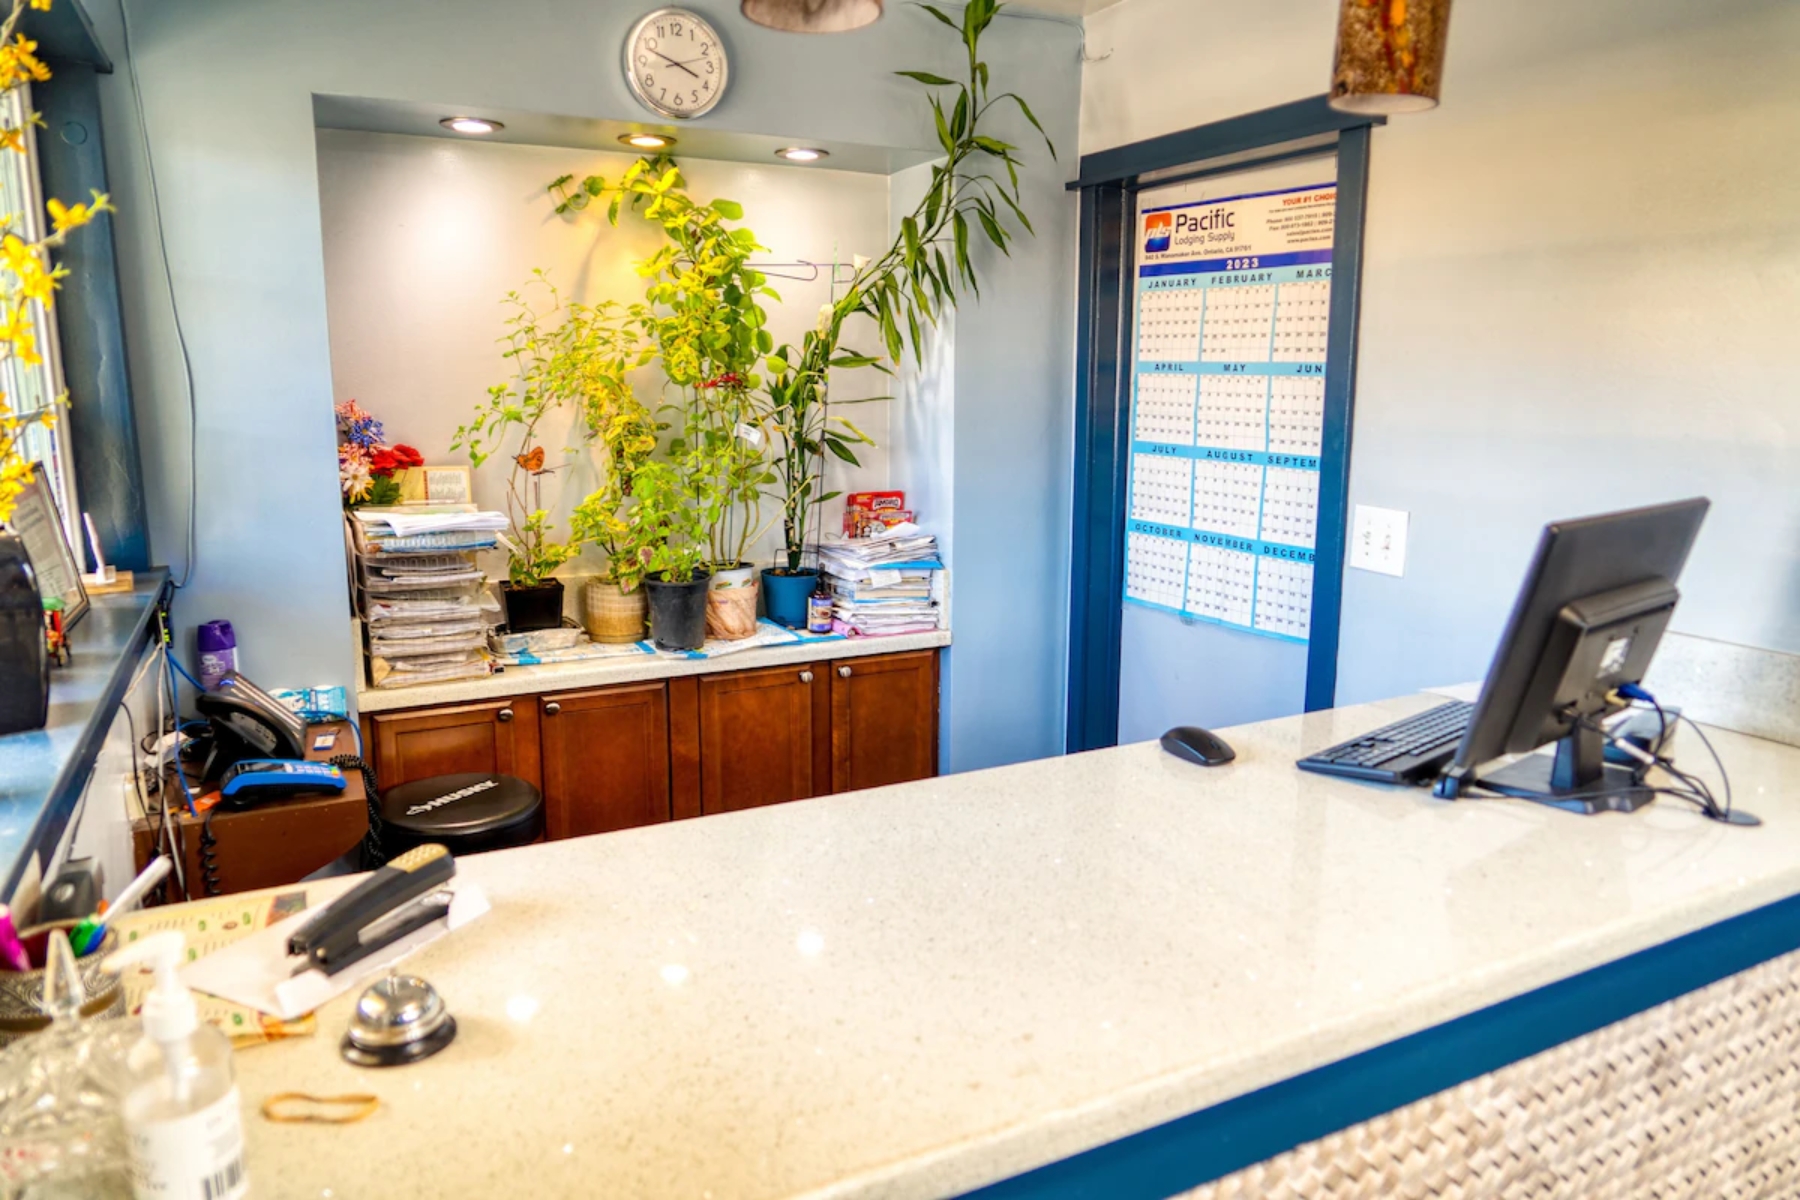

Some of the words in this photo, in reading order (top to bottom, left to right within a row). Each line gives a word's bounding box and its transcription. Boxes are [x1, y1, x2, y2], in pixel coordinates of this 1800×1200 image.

[656, 25, 665, 39] 11
[669, 22, 683, 37] 12
[689, 29, 694, 41] 1
[644, 37, 658, 50] 10
[700, 41, 709, 56] 2
[638, 54, 648, 68] 9
[706, 61, 715, 74] 3
[644, 73, 655, 88] 8
[702, 79, 709, 92] 4
[660, 87, 667, 101] 7
[673, 92, 684, 106] 6
[691, 89, 699, 103] 5
[1282, 196, 1302, 206] YOUR
[1175, 208, 1235, 234] Pacific
[1174, 234, 1205, 246] Lodging
[1207, 231, 1235, 242] Supply
[1226, 257, 1260, 270] 2023
[1148, 277, 1197, 289] JANUARY
[1211, 272, 1273, 285] FEBRUARY
[1295, 268, 1332, 279] MARC
[1154, 363, 1184, 372] APRIL
[1223, 364, 1246, 372] MAY
[1296, 365, 1322, 373] JUN
[1152, 445, 1177, 454] JULY
[1207, 450, 1253, 461] AUGUST
[1268, 456, 1317, 468] SEPTEM
[1135, 523, 1182, 538] OCTOBER
[1193, 533, 1253, 551] NOVEMBER
[1263, 545, 1315, 561] DECEMB
